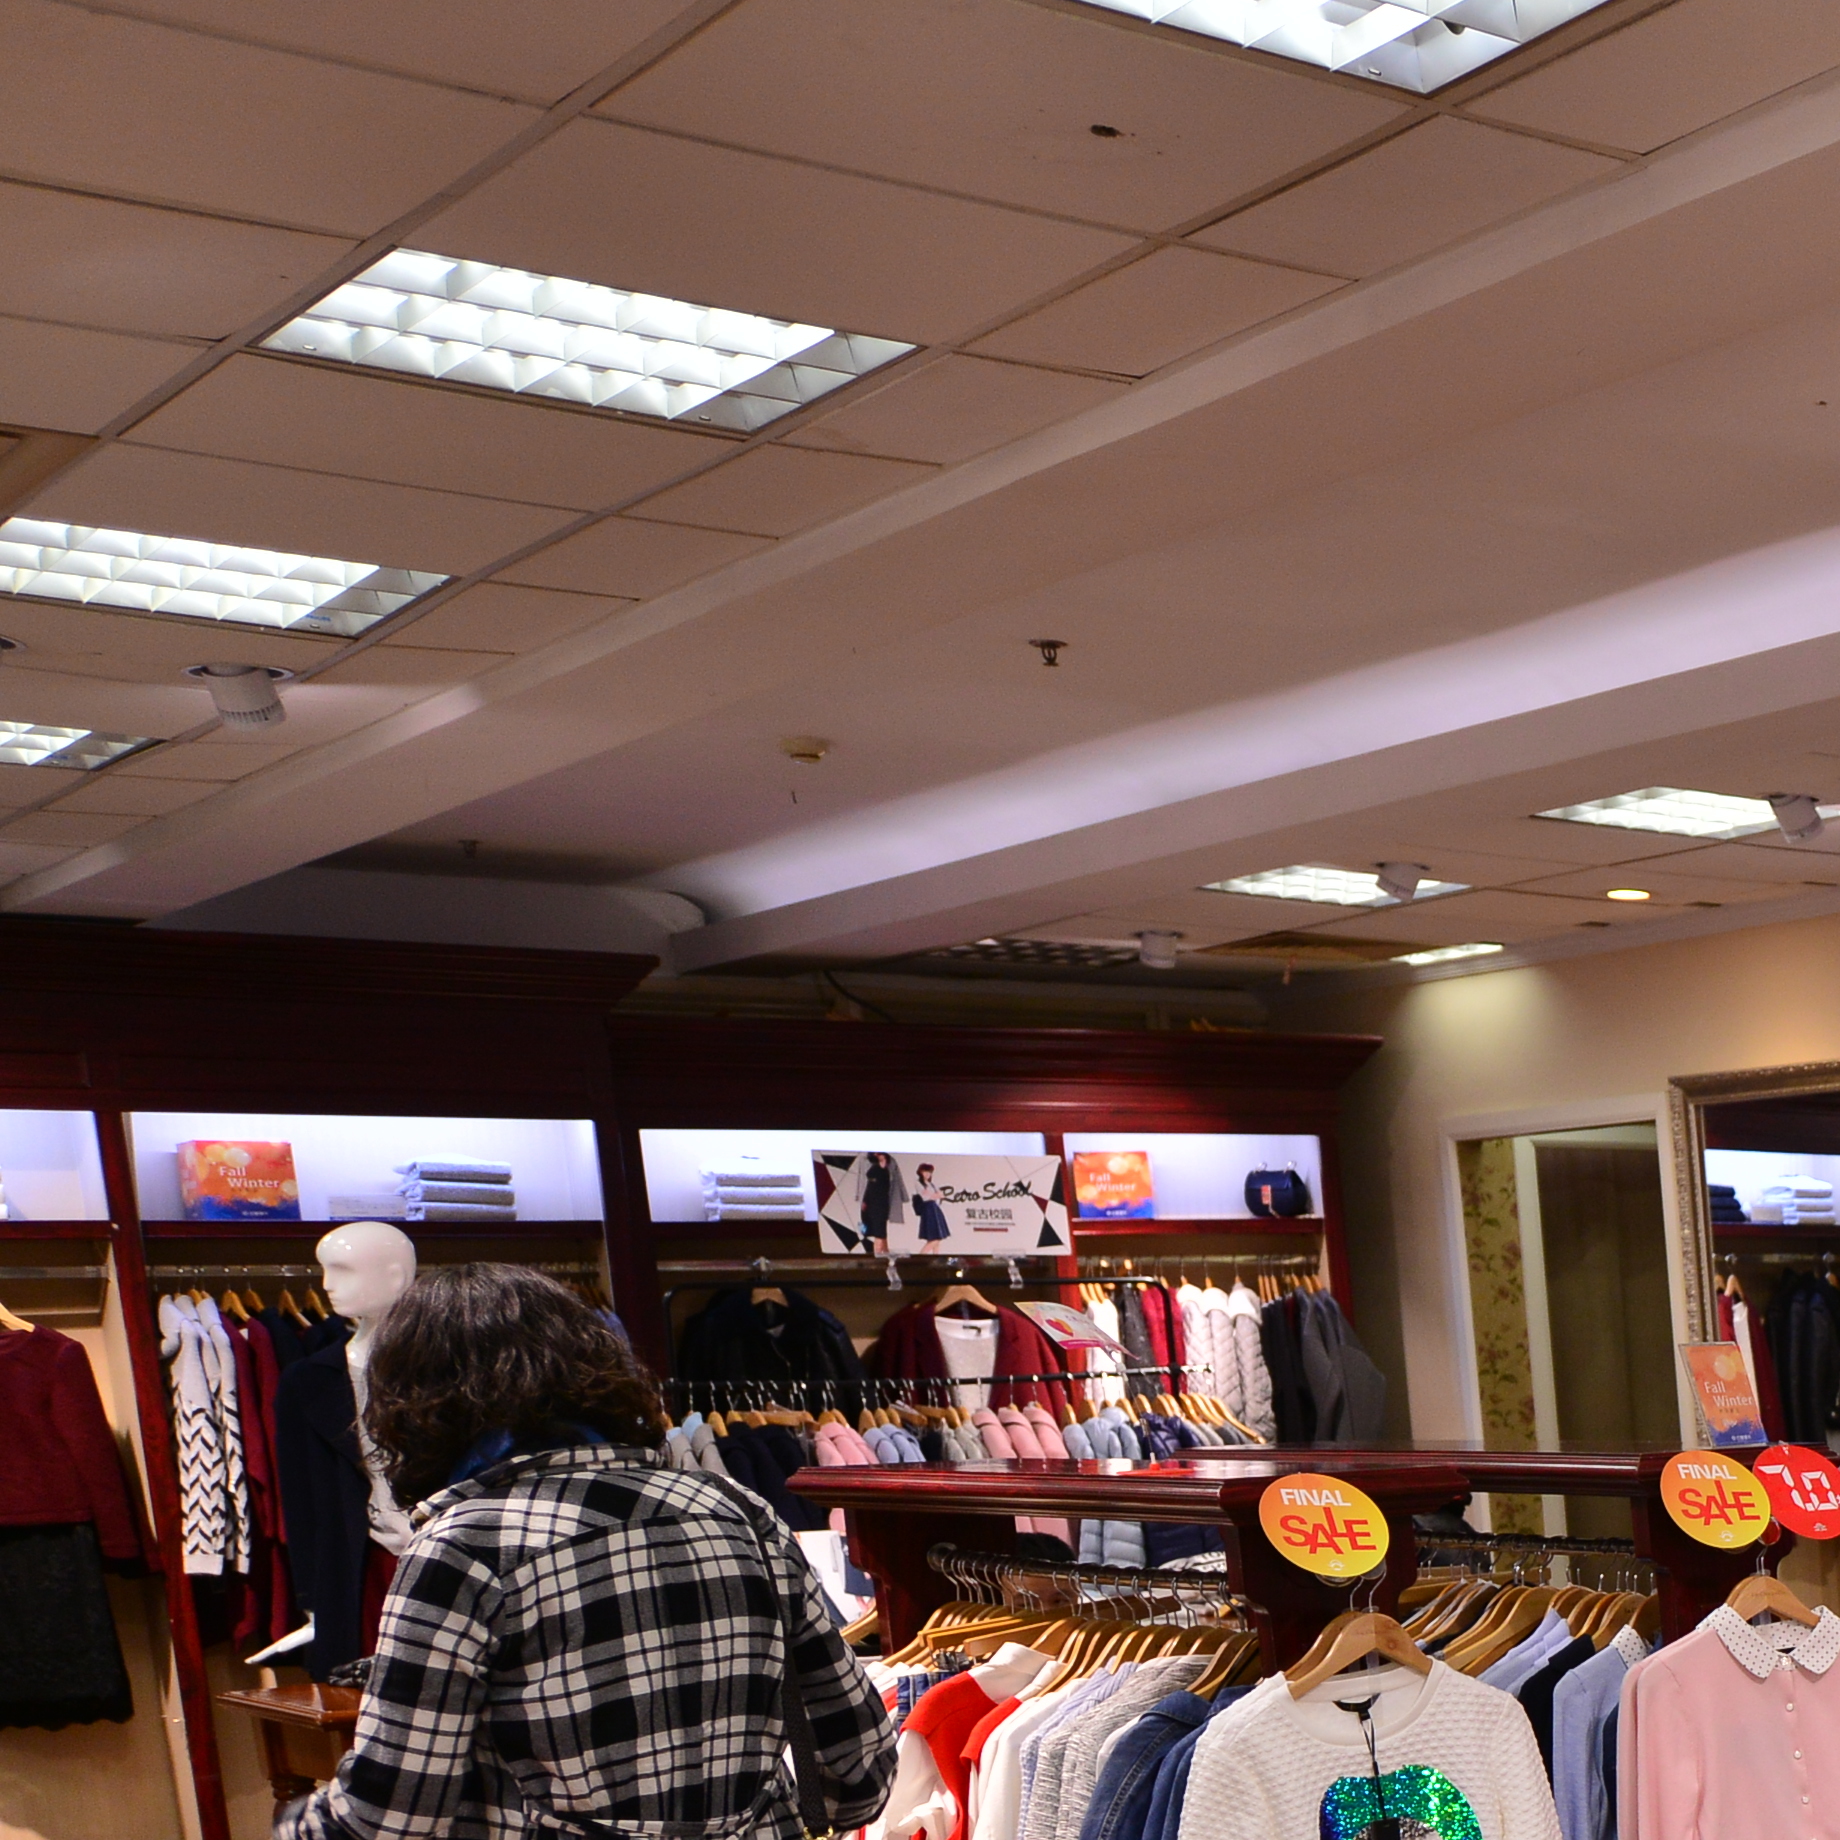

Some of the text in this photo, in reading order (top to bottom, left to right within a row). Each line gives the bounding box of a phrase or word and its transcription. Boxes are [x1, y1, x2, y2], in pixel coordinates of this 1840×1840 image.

[220, 1166, 246, 1176] Fall
[1089, 1172, 1111, 1182] Fall
[227, 1178, 280, 1188] Winter
[1096, 1183, 1136, 1191] Winter
[940, 1180, 1031, 1204] Retro School
[1704, 1381, 1726, 1393] Fall
[1713, 1395, 1752, 1407] Winter
[1677, 1463, 1738, 1480] FINAL
[1280, 1488, 1352, 1506] FINAL
[1678, 1480, 1761, 1526] SALE
[1279, 1507, 1377, 1554] SALE
